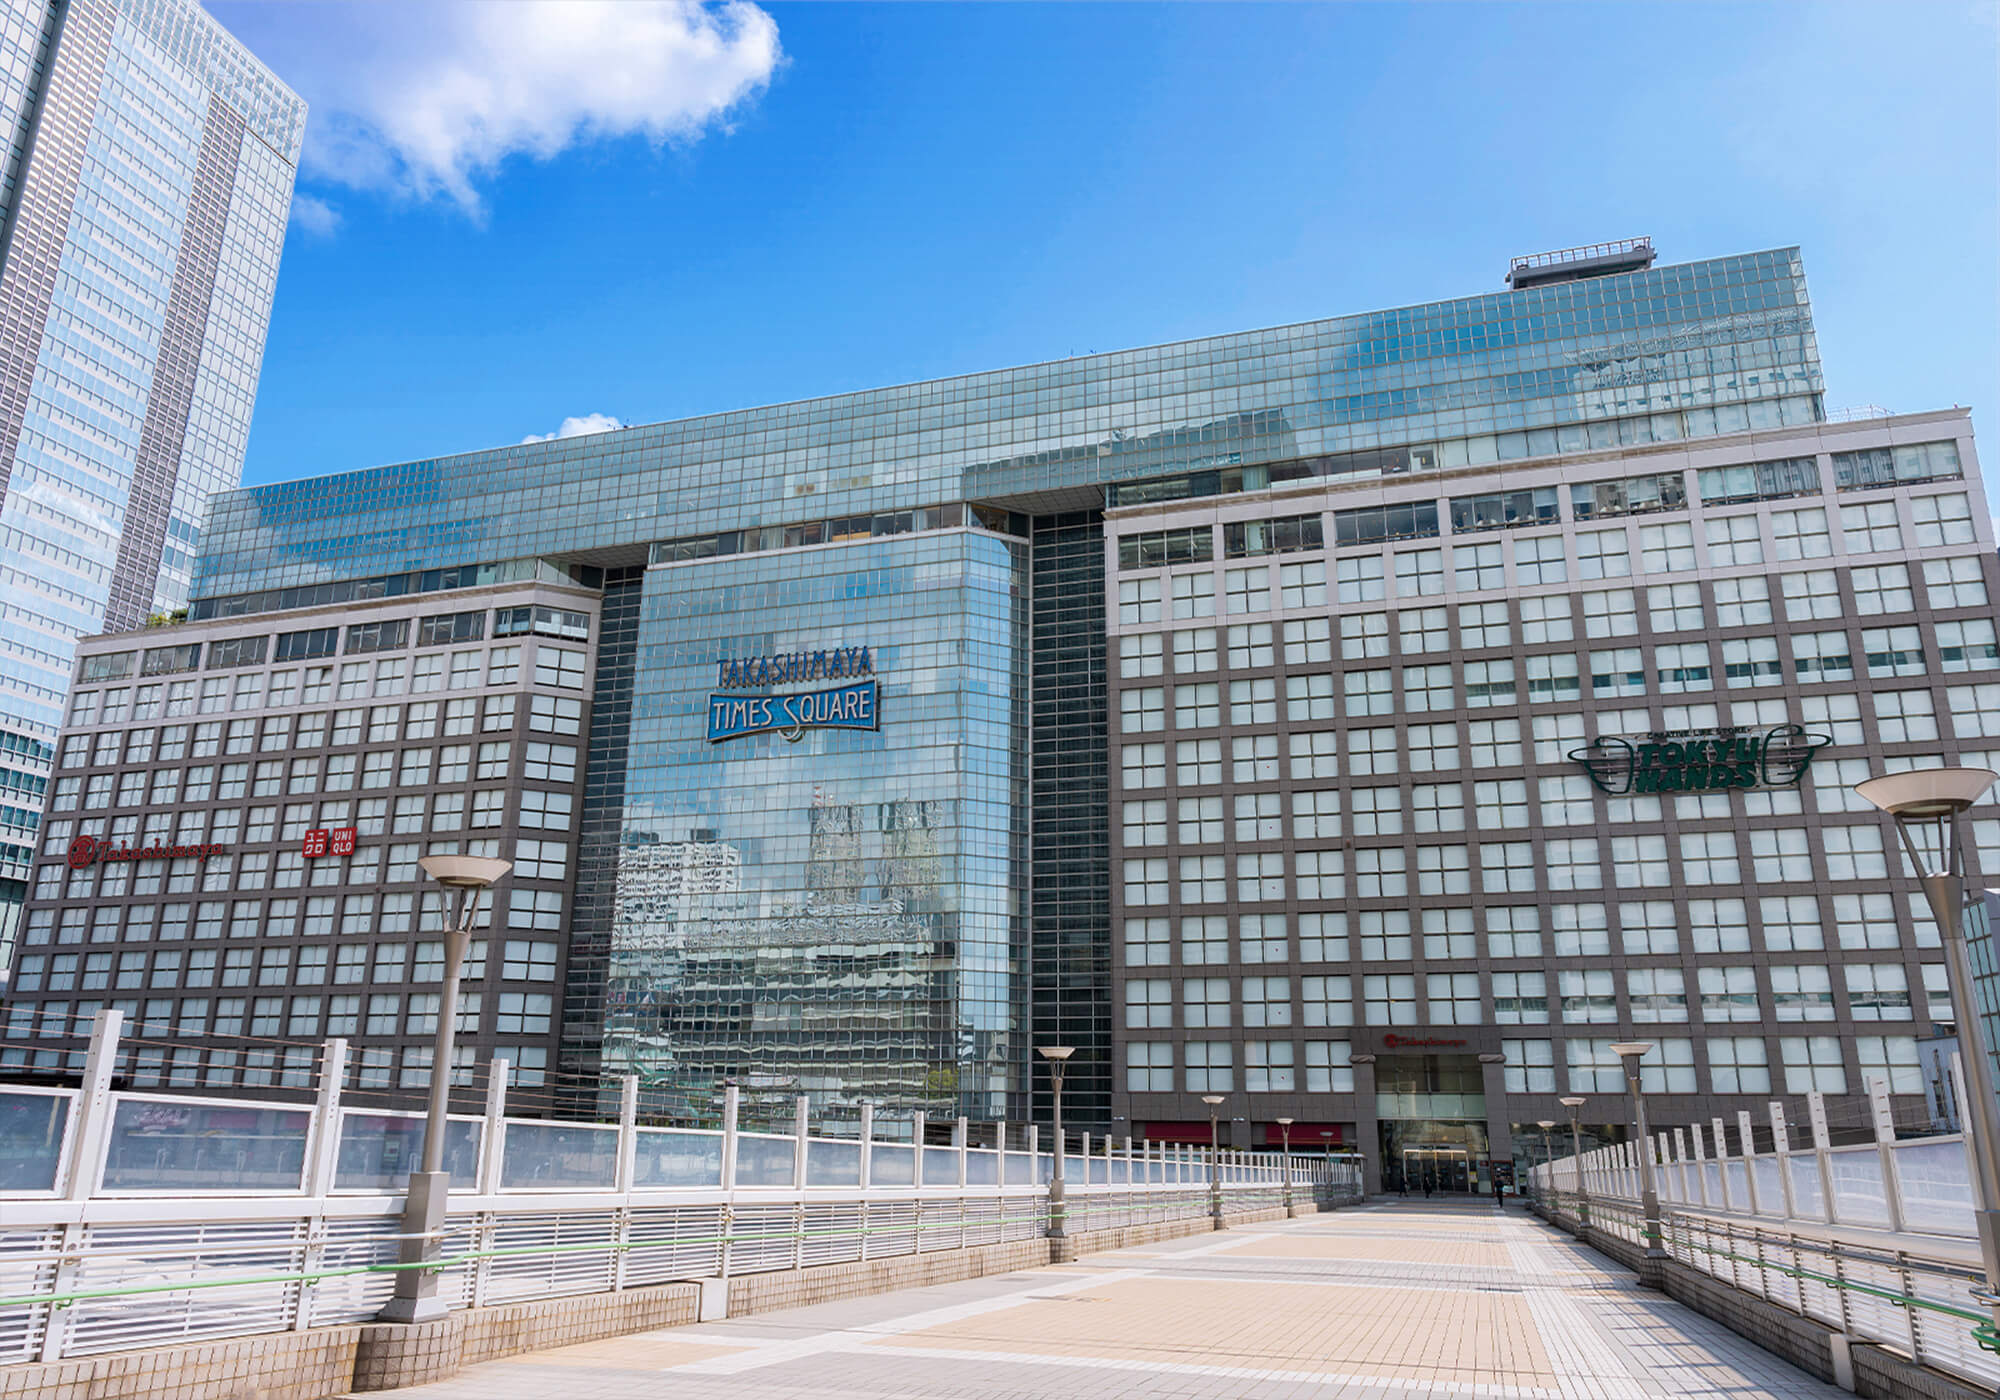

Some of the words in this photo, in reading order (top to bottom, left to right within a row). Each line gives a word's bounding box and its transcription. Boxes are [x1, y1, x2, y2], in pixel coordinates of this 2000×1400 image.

[716, 645, 873, 687] TAKASHIMAYA
[713, 698, 772, 730] TIMES
[777, 690, 870, 740] SQUARE
[1637, 736, 1760, 768] TOKYU
[1636, 764, 1757, 793] HANDS
[333, 841, 352, 855] QLO
[334, 830, 353, 841] UNI
[97, 838, 223, 863] Takashimaya
